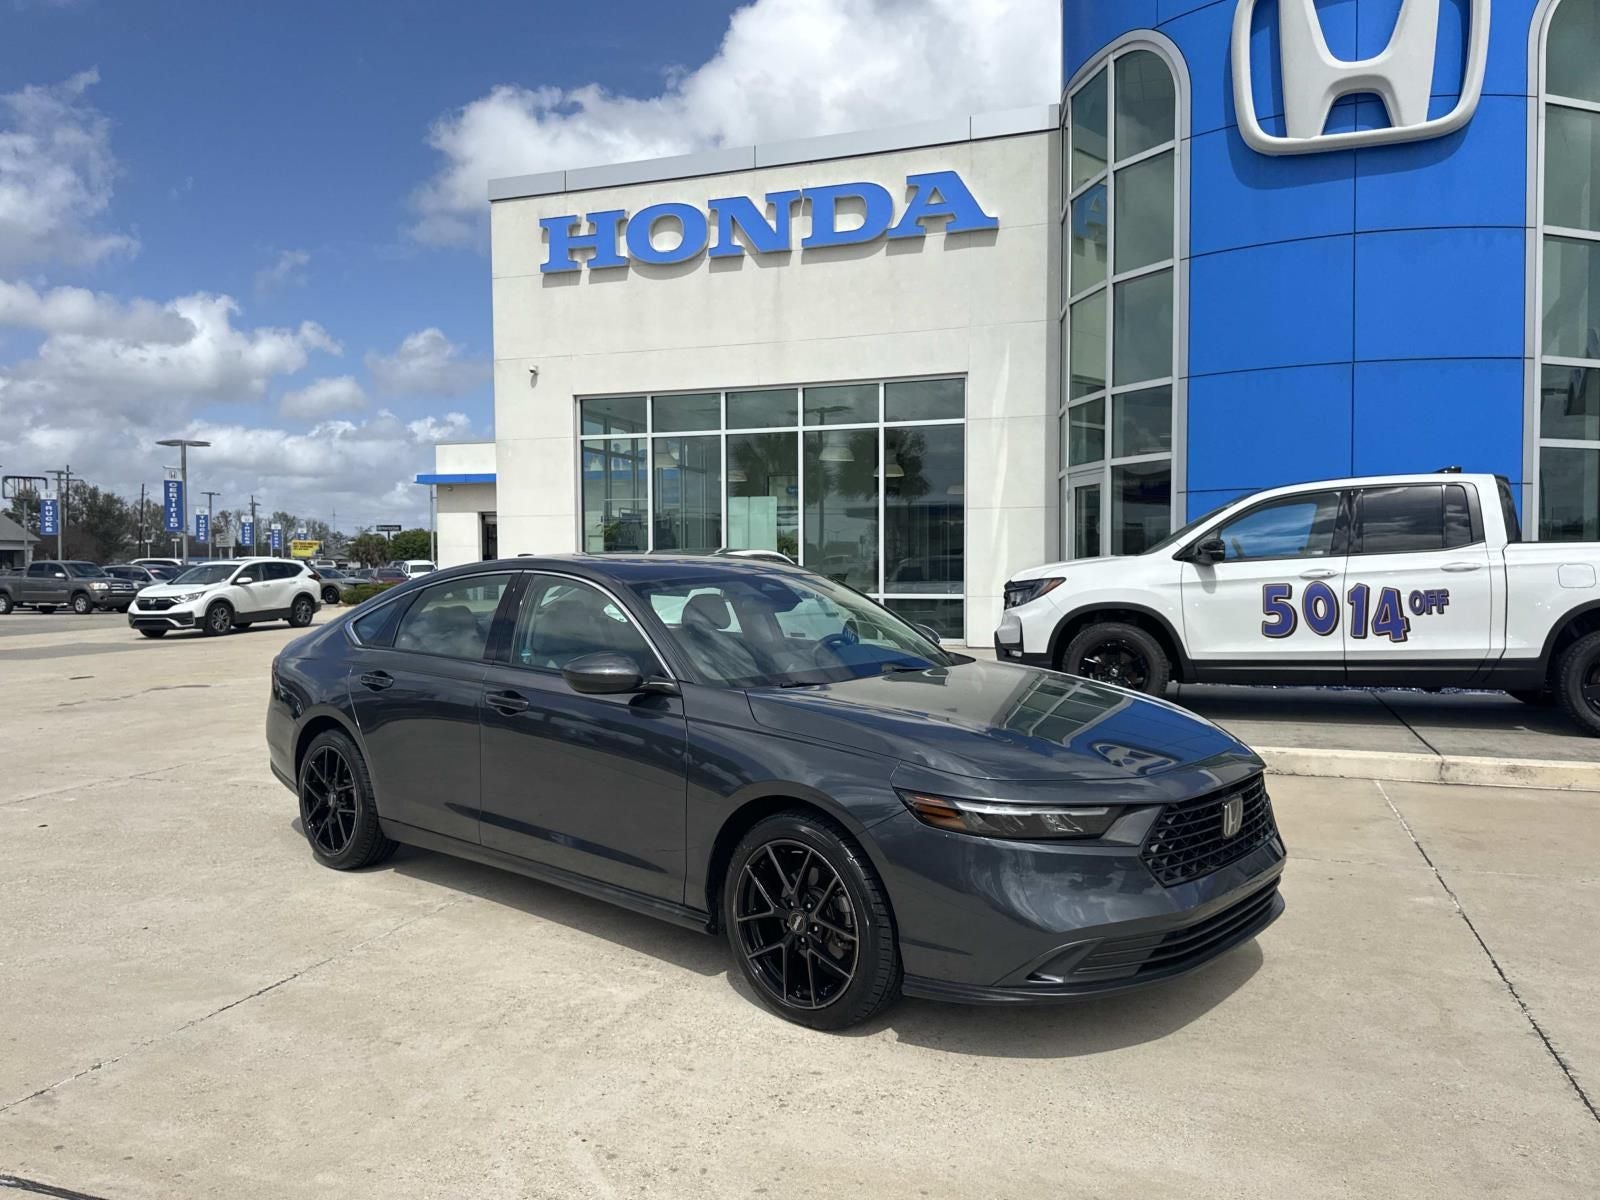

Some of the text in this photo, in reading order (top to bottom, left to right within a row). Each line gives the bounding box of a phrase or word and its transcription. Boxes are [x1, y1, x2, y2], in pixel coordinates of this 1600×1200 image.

[539, 169, 999, 275] HONDA
[45, 500, 53, 532] TRUCKS
[168, 482, 178, 528] CERTIFIED
[1261, 580, 1449, 643] 5014 OFF
